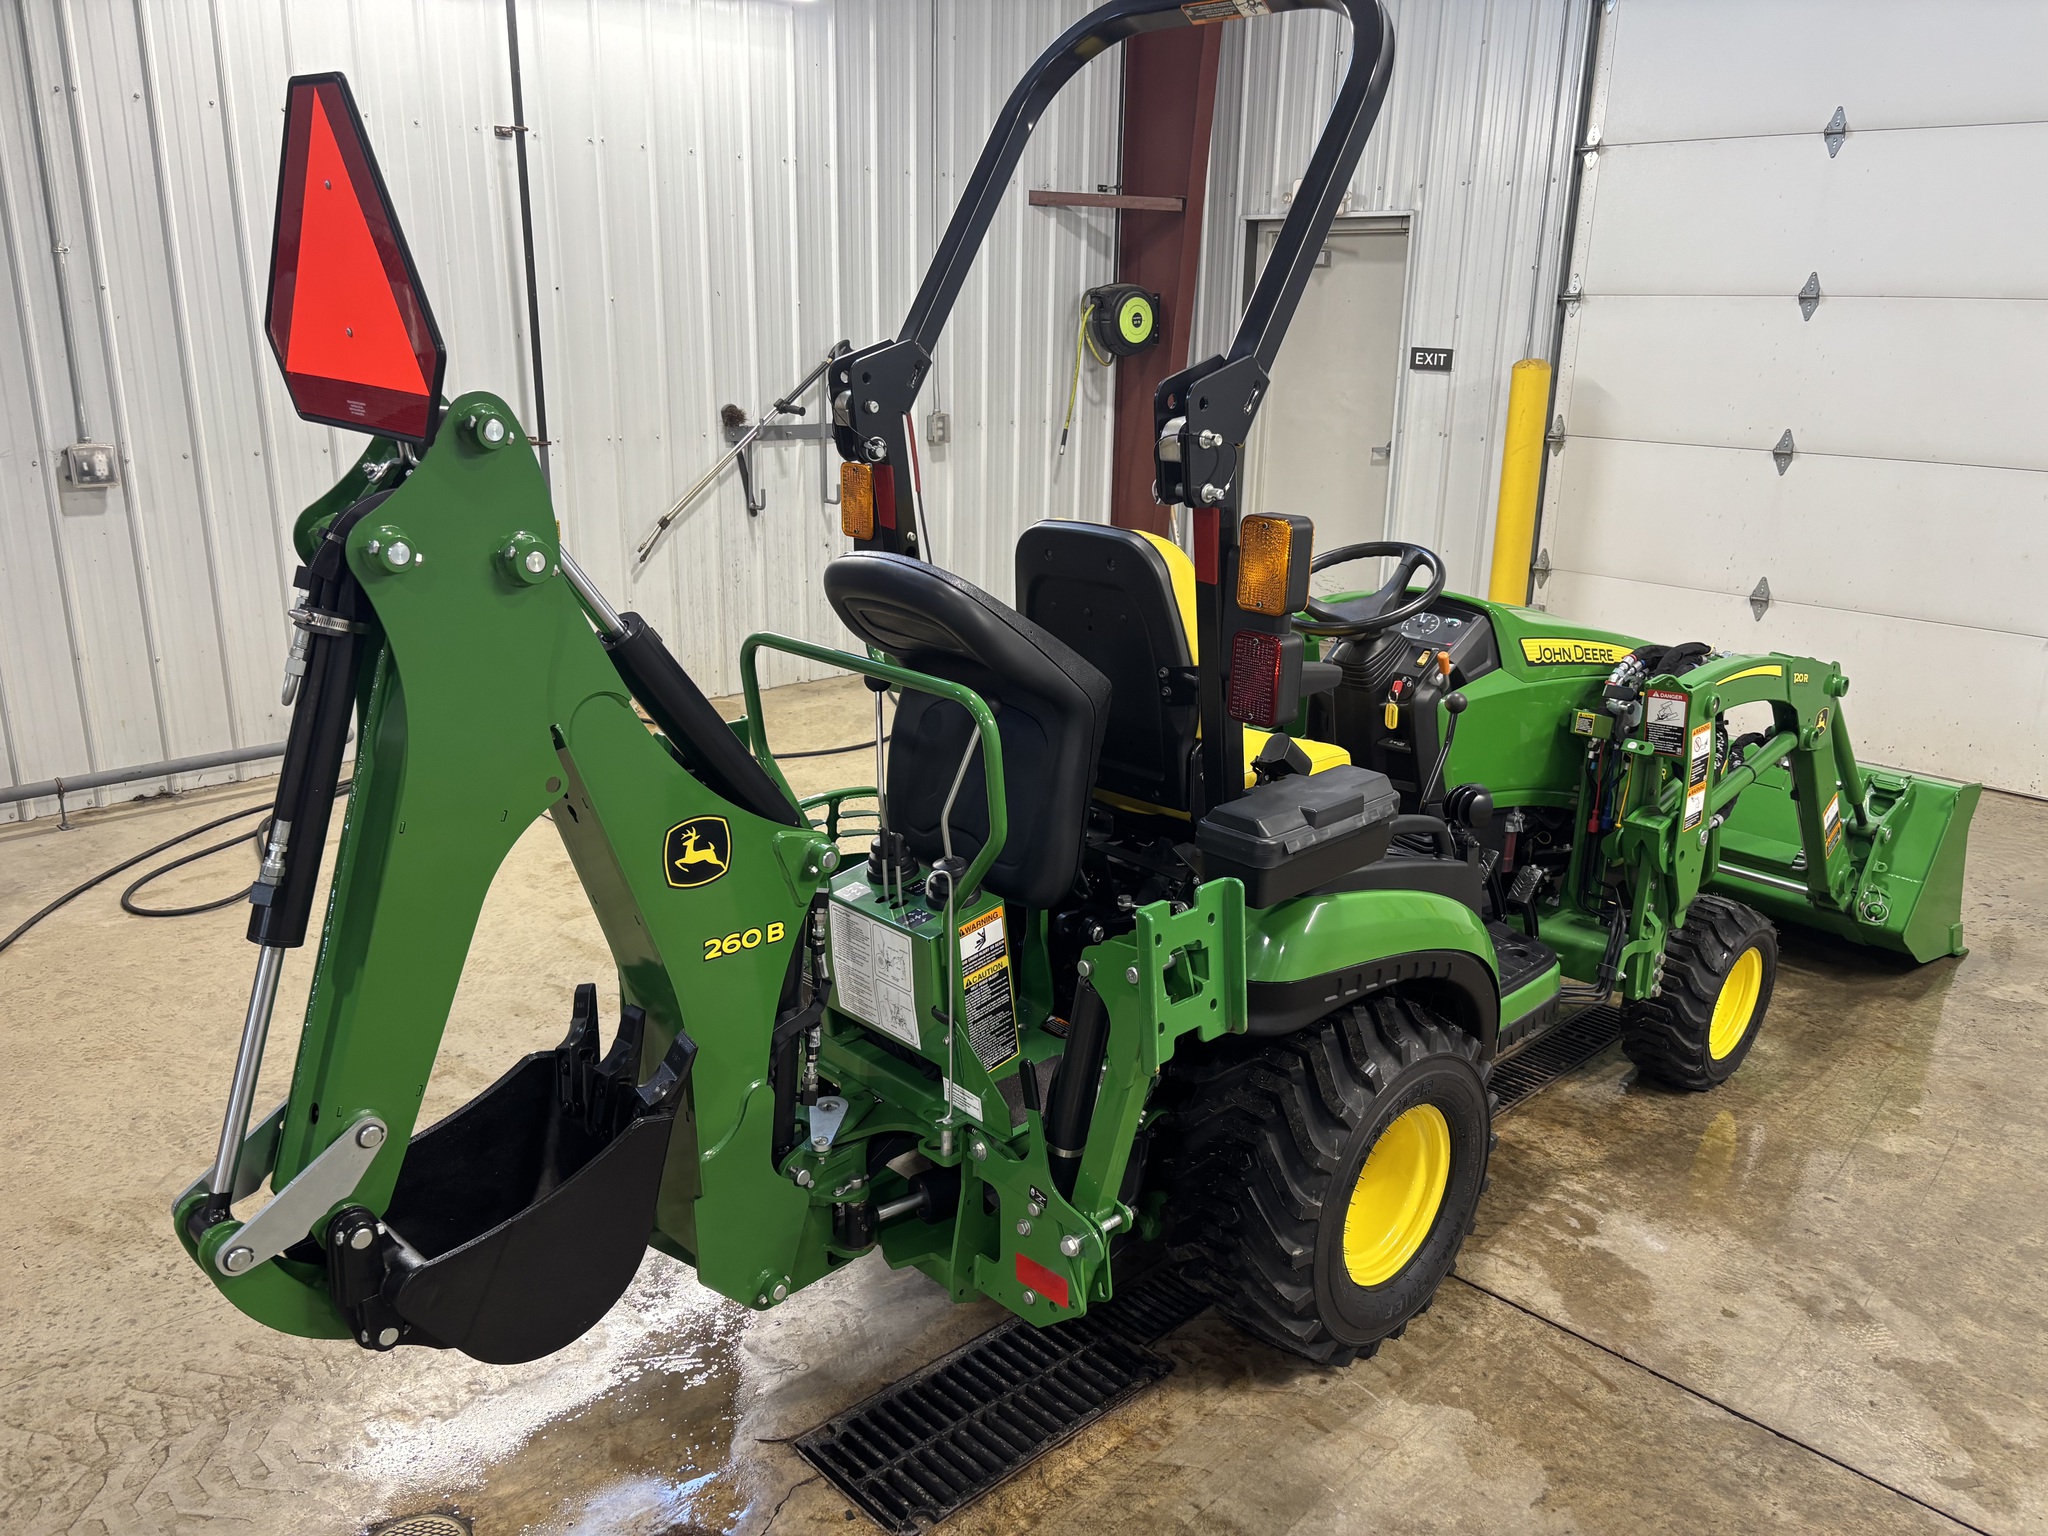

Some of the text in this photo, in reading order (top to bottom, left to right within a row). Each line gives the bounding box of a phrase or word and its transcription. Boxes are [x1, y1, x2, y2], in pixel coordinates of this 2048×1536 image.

[1415, 352, 1447, 366] EXIT
[1535, 644, 1614, 662] JOHN DEERE
[1660, 692, 1683, 700] DANGER
[964, 911, 999, 934] WARNING
[704, 920, 786, 961] 260 B
[971, 961, 1004, 984] CAUTION
